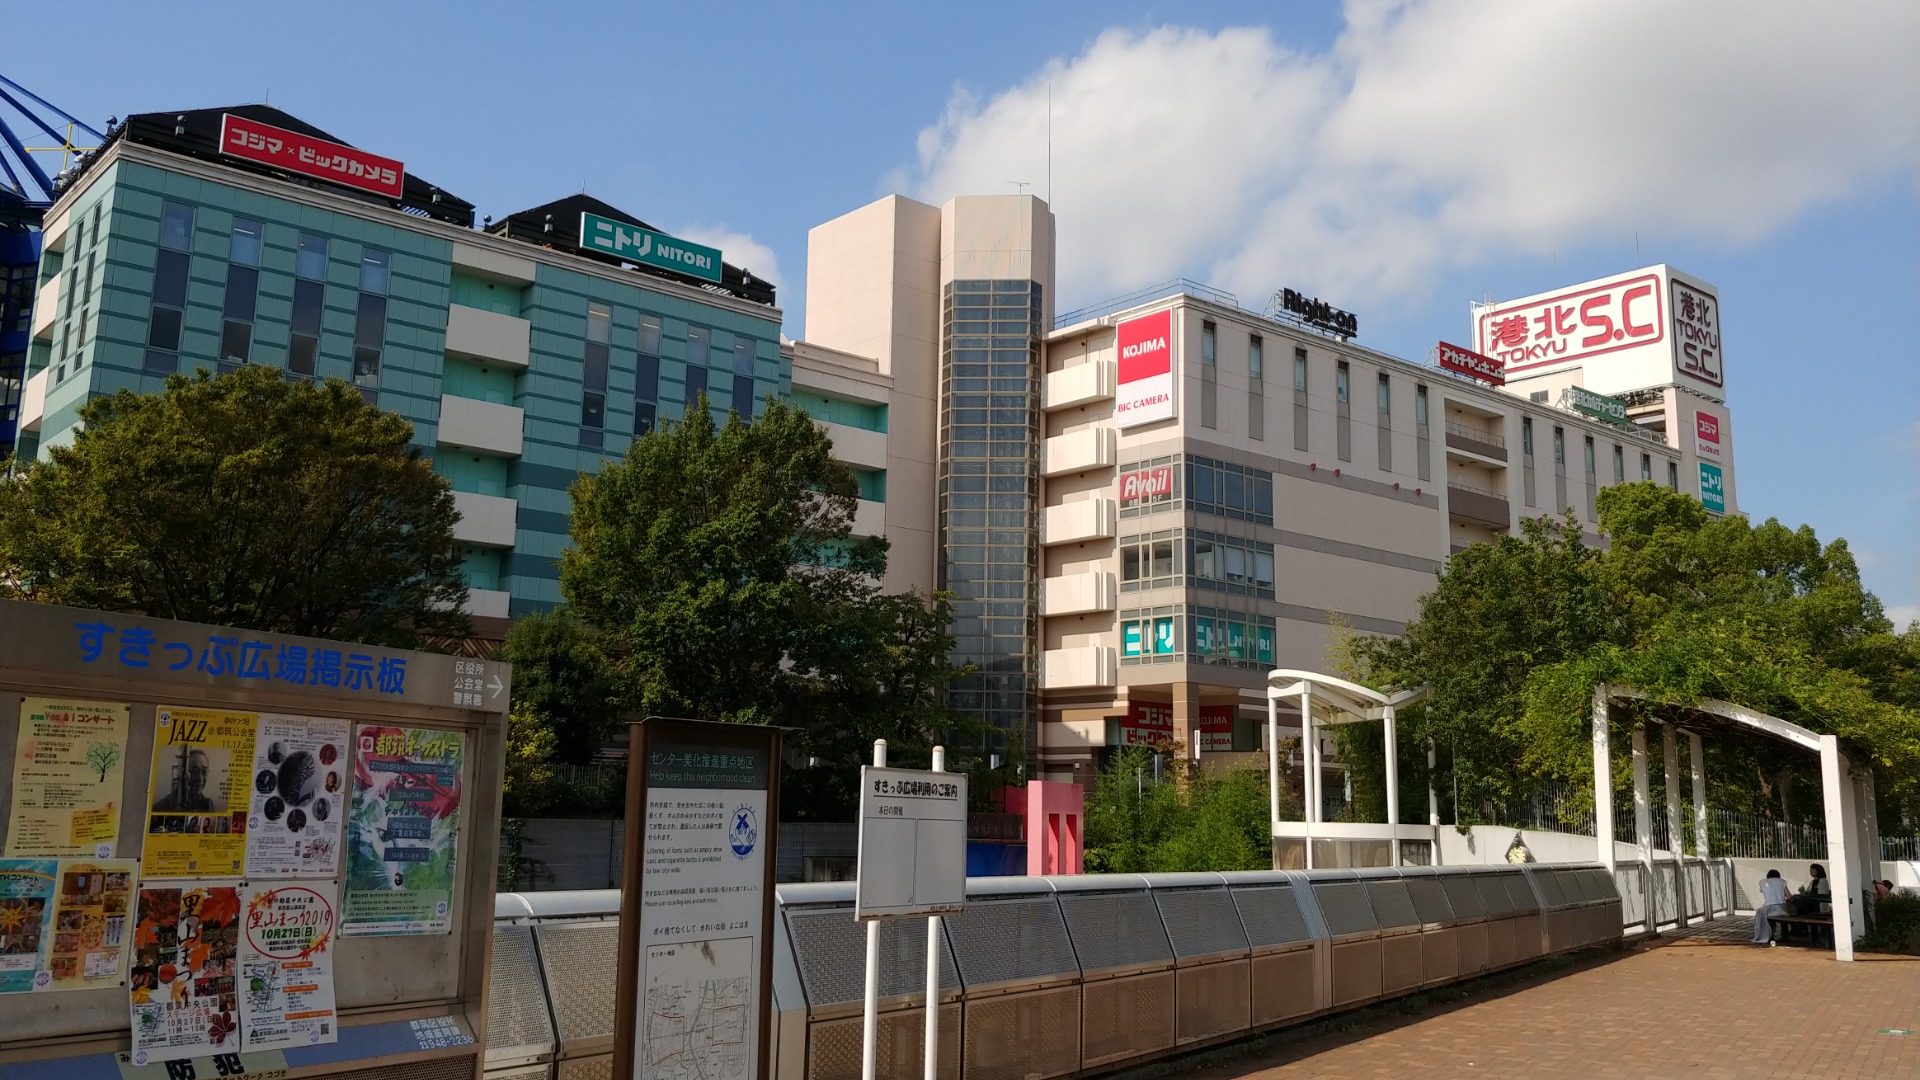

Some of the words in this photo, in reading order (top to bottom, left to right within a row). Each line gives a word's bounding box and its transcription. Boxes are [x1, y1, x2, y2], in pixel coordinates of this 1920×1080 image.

[594, 221, 652, 257] ニトリ
[657, 243, 712, 270] NITORI
[1284, 287, 1358, 332] Right-on
[1680, 290, 1711, 328] 港北
[1490, 305, 1577, 351] 港北
[1676, 321, 1717, 349] TOKYU
[1122, 336, 1166, 359] KOJIMA
[1499, 338, 1568, 366] TOKYU
[1118, 402, 1132, 413] BIC
[1133, 393, 1170, 409] CAMERA
[1698, 419, 1717, 436] コジマ
[1124, 469, 1168, 498] Avail
[1701, 471, 1722, 492] ニトリ
[1703, 490, 1724, 504] NITORI
[74, 621, 407, 695] すきっぷ広場掲示板
[455, 661, 485, 676] 区役所
[454, 676, 484, 691] 公会堂
[77, 714, 115, 724] コンサート
[167, 719, 208, 746] JAZZ
[216, 726, 256, 738] 都筑公会堂
[651, 751, 755, 769] センター美化推進重点地区
[650, 770, 665, 780] Help
[665, 770, 683, 782] keep
[683, 770, 695, 781] this
[696, 772, 738, 784] neighborhood
[874, 779, 958, 798] すきっぷ広場利用のご案内
[878, 805, 904, 817] 本日の開催
[250, 910, 331, 929] 里山まつり2019
[653, 924, 697, 936] ポイ捨てなくして
[700, 922, 726, 932] きれいな街
[729, 920, 749, 930] よこはま
[261, 926, 317, 940] 10月27日(日)
[178, 894, 201, 1007] 里山まつり
[651, 949, 676, 958] センター地区
[167, 1007, 211, 1019] ステージ広場
[409, 1016, 456, 1031] 都筑区役所
[267, 1069, 287, 1078] つづき
